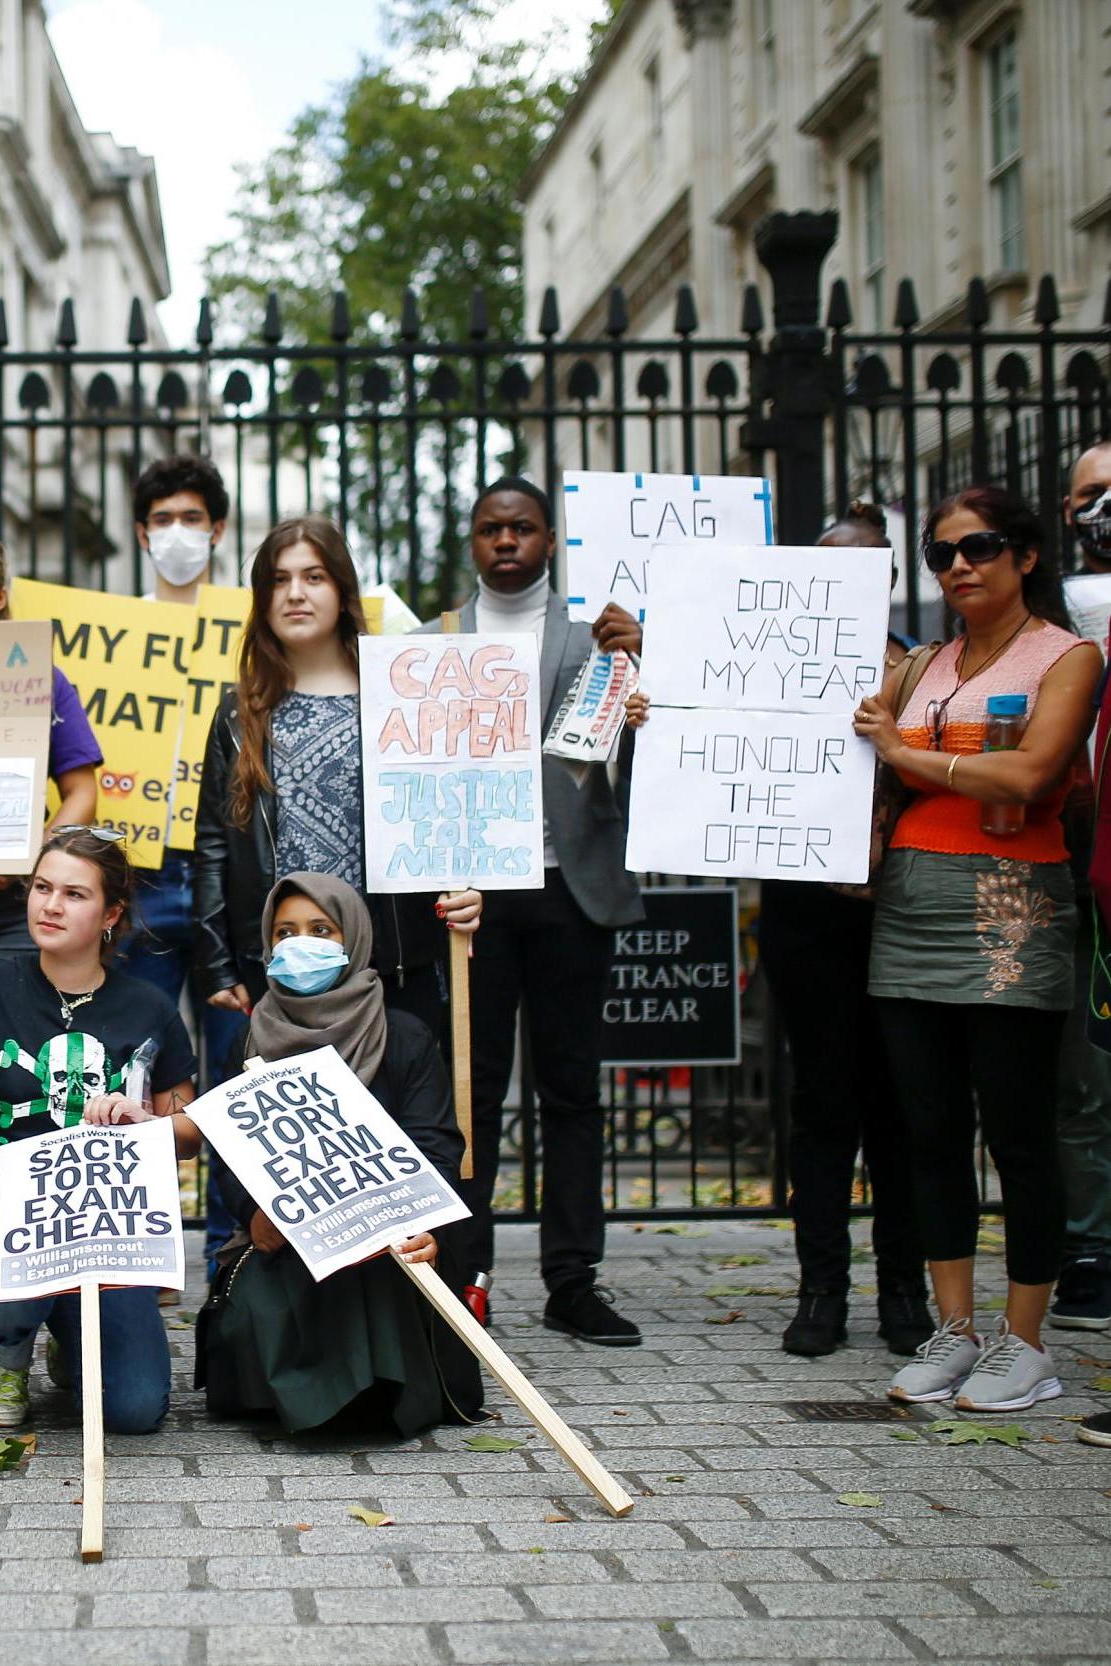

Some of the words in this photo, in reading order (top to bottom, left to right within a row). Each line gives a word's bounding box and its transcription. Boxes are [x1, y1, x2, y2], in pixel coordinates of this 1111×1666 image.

[630, 498, 716, 538] CAG
[737, 575, 842, 612] DON'T
[6, 642, 28, 668] A
[51, 619, 128, 664] MY
[723, 616, 862, 658] WASTE
[576, 655, 612, 718] TORIES
[703, 659, 756, 697] MY
[773, 662, 877, 702] YEAR
[378, 699, 531, 758] APPEAL
[679, 734, 845, 775] HONOUR
[378, 770, 534, 824] JUSTICE
[721, 783, 797, 818] THE
[413, 820, 488, 848] FOR
[704, 823, 832, 869] OFFER
[386, 843, 532, 878] MEDICS
[614, 930, 690, 956] KEEP
[611, 962, 730, 990] TRANCE
[601, 998, 701, 1024] CLEAR
[225, 1074, 270, 1101] Socialist
[266, 1065, 303, 1084] Worker
[227, 1071, 337, 1131] SACK
[40, 1131, 86, 1147] Socialist
[87, 1130, 128, 1139] Worker
[246, 1098, 348, 1157] TORY
[29, 1139, 141, 1173] SACK
[263, 1124, 384, 1191] EXAM
[30, 1162, 138, 1196] TORY
[271, 1146, 422, 1225] CHEATS
[24, 1186, 148, 1225] EXAM
[311, 1192, 388, 1237] Williamson
[387, 1183, 415, 1204] out
[323, 1222, 367, 1250] Exam
[365, 1202, 412, 1234] justice
[412, 1192, 442, 1212] now
[3, 1211, 172, 1254] CHEATS
[25, 1241, 113, 1268] Williamson
[116, 1241, 145, 1253] out
[26, 1264, 70, 1281] Exam
[72, 1255, 128, 1273] justice
[131, 1256, 165, 1266] now
